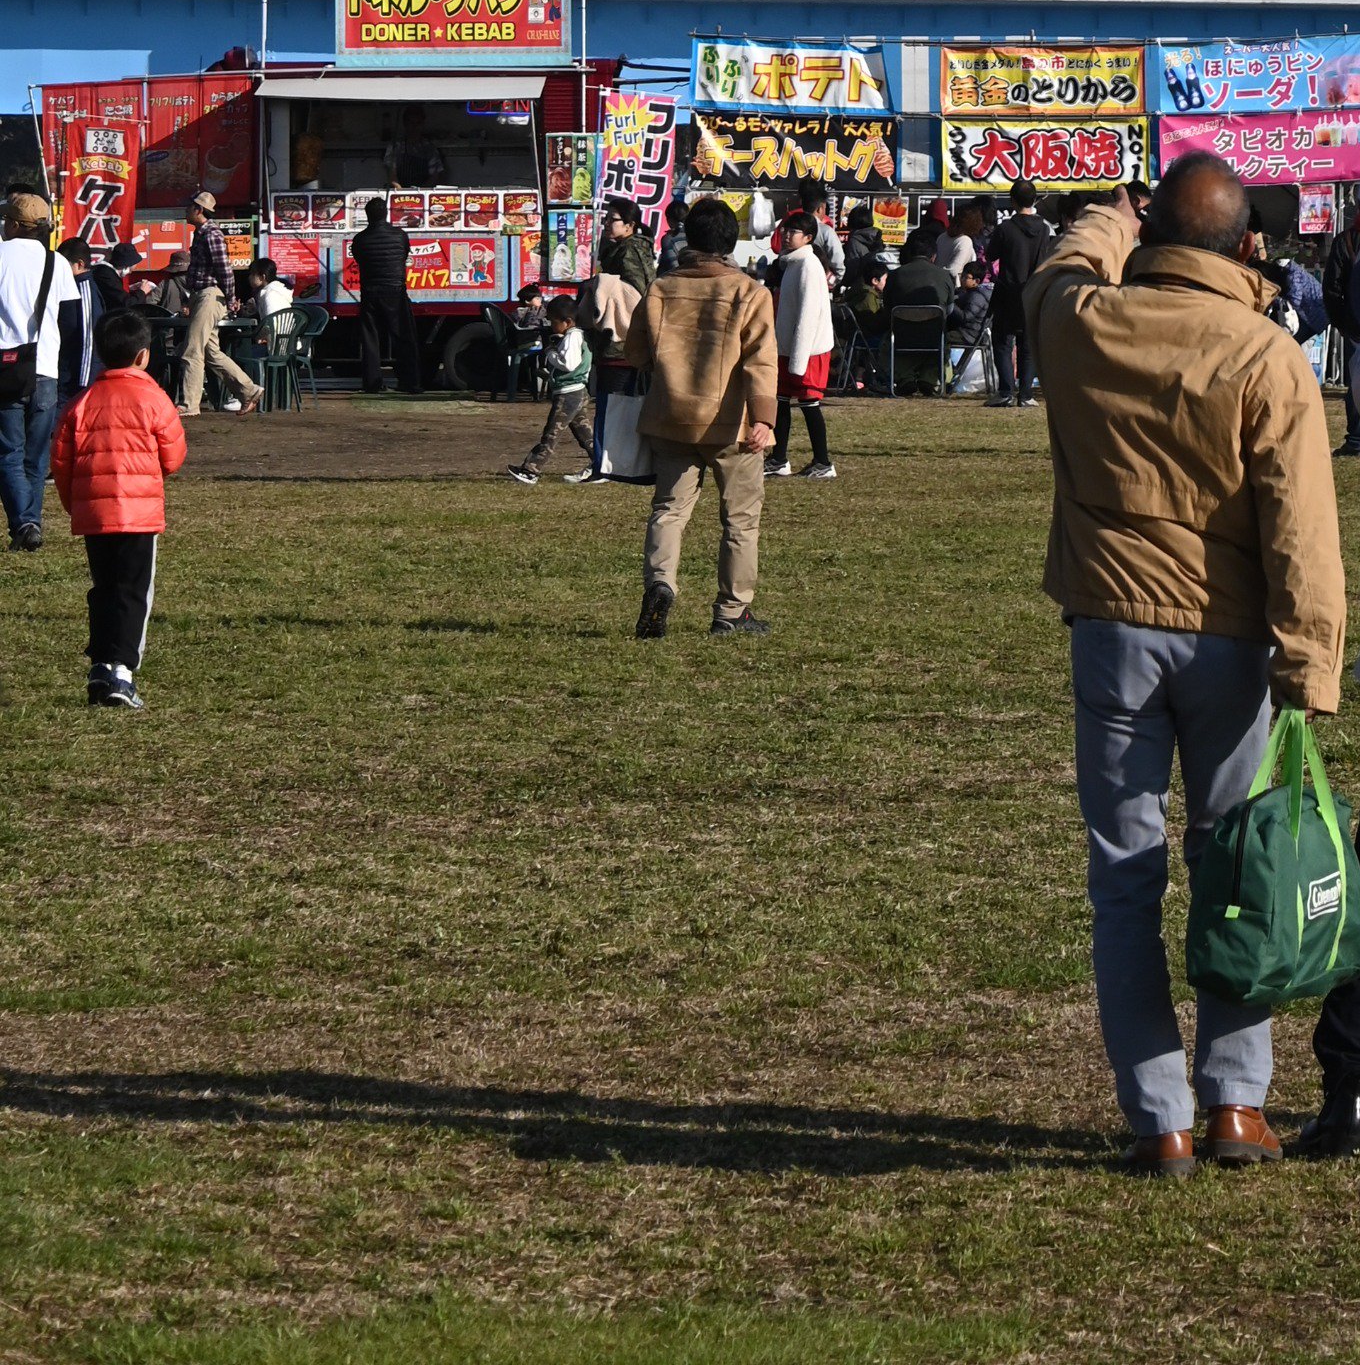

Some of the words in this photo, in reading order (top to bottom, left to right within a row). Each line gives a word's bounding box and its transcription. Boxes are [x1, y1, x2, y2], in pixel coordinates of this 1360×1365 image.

[361, 23, 431, 42] DONER
[446, 22, 516, 42] KEBAB
[1203, 52, 1324, 78] ほにゅうビン
[751, 52, 883, 102] ポテト
[949, 74, 1139, 108] 黄金のとりから
[1202, 73, 1320, 112] ソーダ!
[606, 111, 637, 130] Furi
[613, 129, 645, 147] Furi
[1213, 127, 1315, 154] タピオカ
[80, 158, 124, 173] Kebab
[704, 134, 878, 183] チーズハットグ
[970, 127, 1124, 181] 大阪焼
[393, 194, 421, 204] KEBAB
[431, 195, 461, 205] たこ焼き
[466, 195, 497, 205] からあげ
[557, 213, 567, 239] バニラ
[406, 268, 450, 289] ケバブ
